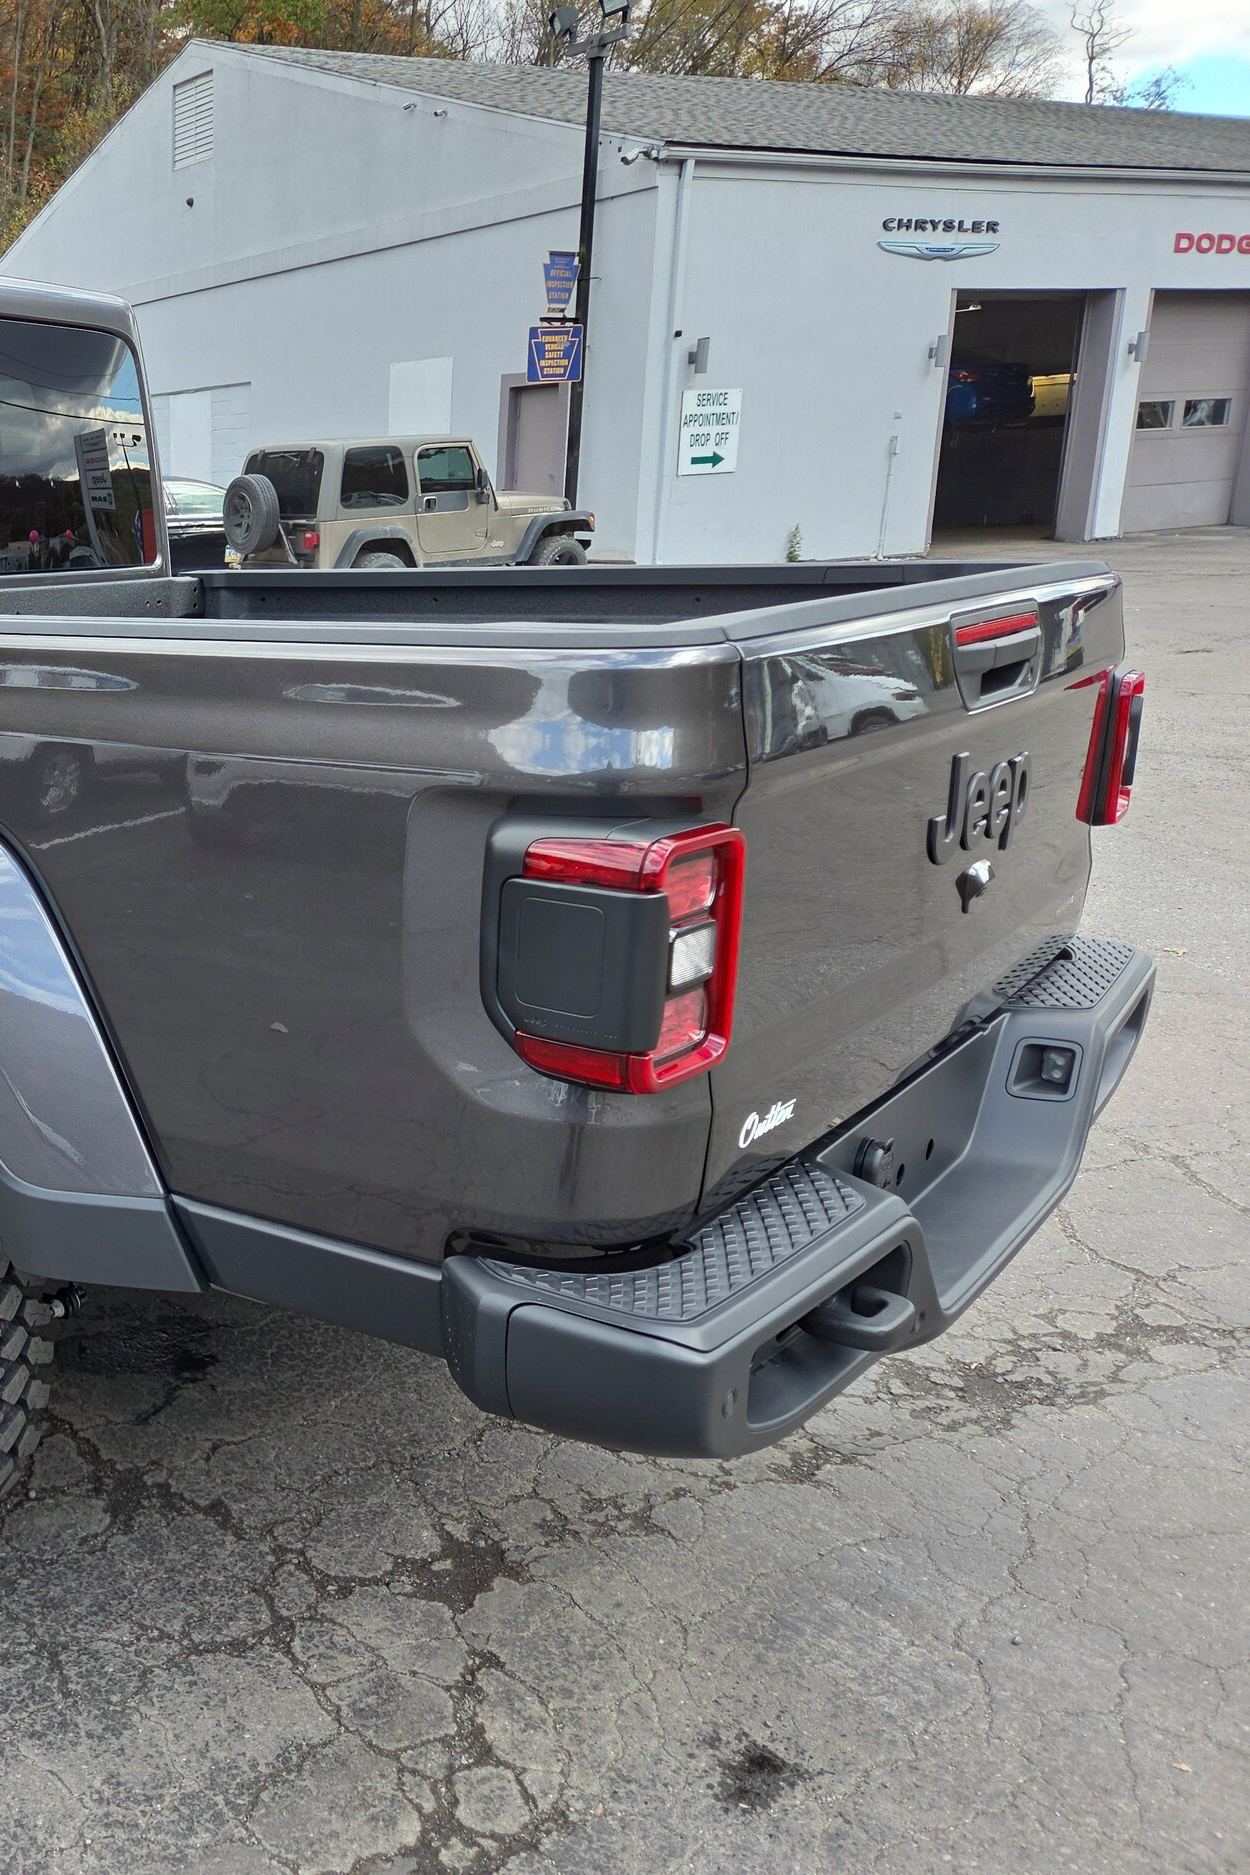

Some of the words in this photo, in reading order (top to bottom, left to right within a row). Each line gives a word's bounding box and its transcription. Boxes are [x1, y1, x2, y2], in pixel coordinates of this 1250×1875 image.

[882, 217, 1000, 234] CHRYSLER
[550, 269, 572, 278] OFFICIAL
[547, 280, 574, 289] INSPECTION
[542, 335, 568, 343] ENHANCED
[545, 351, 564, 359] SAFETY
[540, 359, 569, 367] INSPECTION
[544, 367, 564, 375] STATION
[697, 392, 729, 407] SERVICE
[689, 433, 711, 448] DROP
[714, 431, 730, 446] OFF
[528, 505, 562, 513] RUBICON
[926, 751, 1031, 866] Jeep
